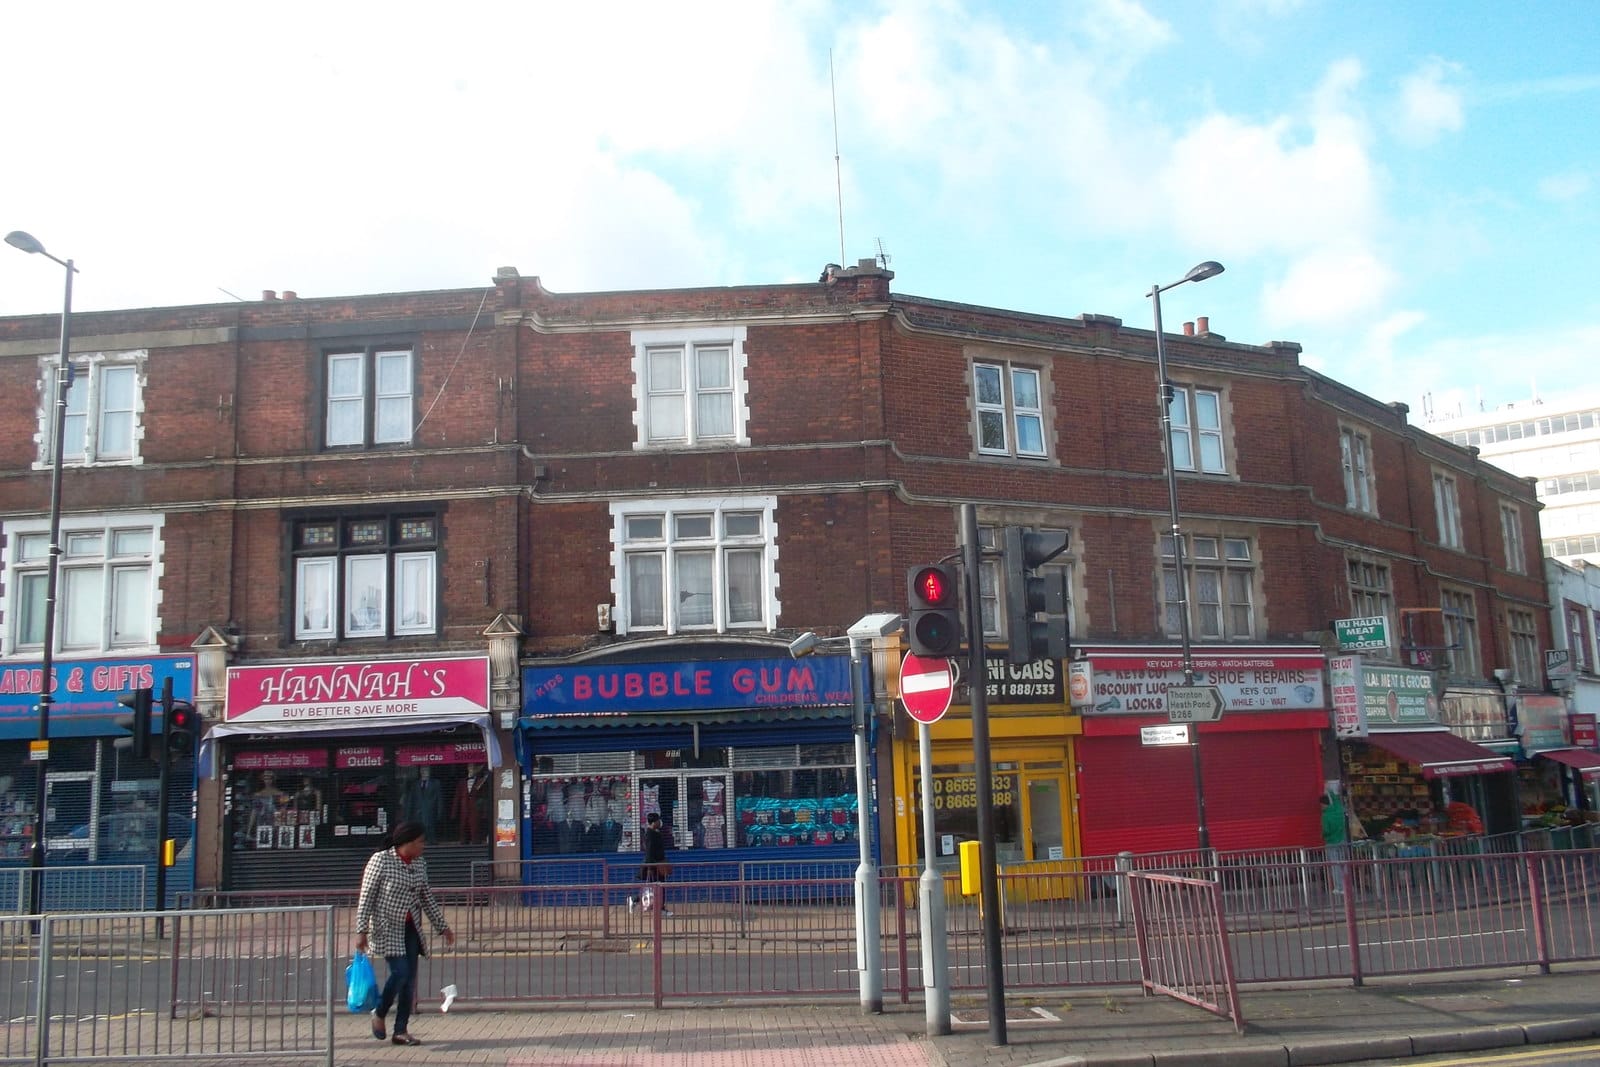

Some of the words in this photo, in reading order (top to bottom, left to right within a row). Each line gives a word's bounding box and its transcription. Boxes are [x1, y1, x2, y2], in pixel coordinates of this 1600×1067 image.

[1338, 621, 1351, 629] MJ
[1353, 618, 1382, 627] HALAL
[1346, 626, 1375, 636] MEAT
[1009, 659, 1055, 680] CABS
[1147, 660, 1159, 668] KEY
[1160, 660, 1173, 668] CUT
[67, 666, 84, 692] &
[92, 664, 154, 691] GIFTS
[573, 670, 713, 700] BUBBLE
[732, 666, 815, 694] GUM
[1208, 671, 1245, 684] SHOE
[1254, 671, 1305, 684] REPAIRS
[535, 673, 564, 697] KIDS
[1009, 683, 1056, 696] 888/333
[1240, 687, 1259, 696] KEYS
[1263, 687, 1277, 695] CUT
[755, 692, 818, 704] CHILDREN'S
[825, 690, 855, 702] WEA
[1170, 691, 1203, 699] Thornton
[1232, 698, 1253, 706] WHILE
[1271, 697, 1287, 705] WAIT
[283, 708, 306, 718] BUY
[308, 706, 351, 717] BETTER
[354, 704, 384, 716] SAVE
[385, 703, 418, 714] MORE
[1126, 698, 1163, 711] LOCKS
[1170, 701, 1192, 709] Heath
[1192, 700, 1211, 708] Pond
[347, 756, 382, 767] Outlet
[945, 778, 977, 792] 8665
[946, 794, 977, 809] 8665
